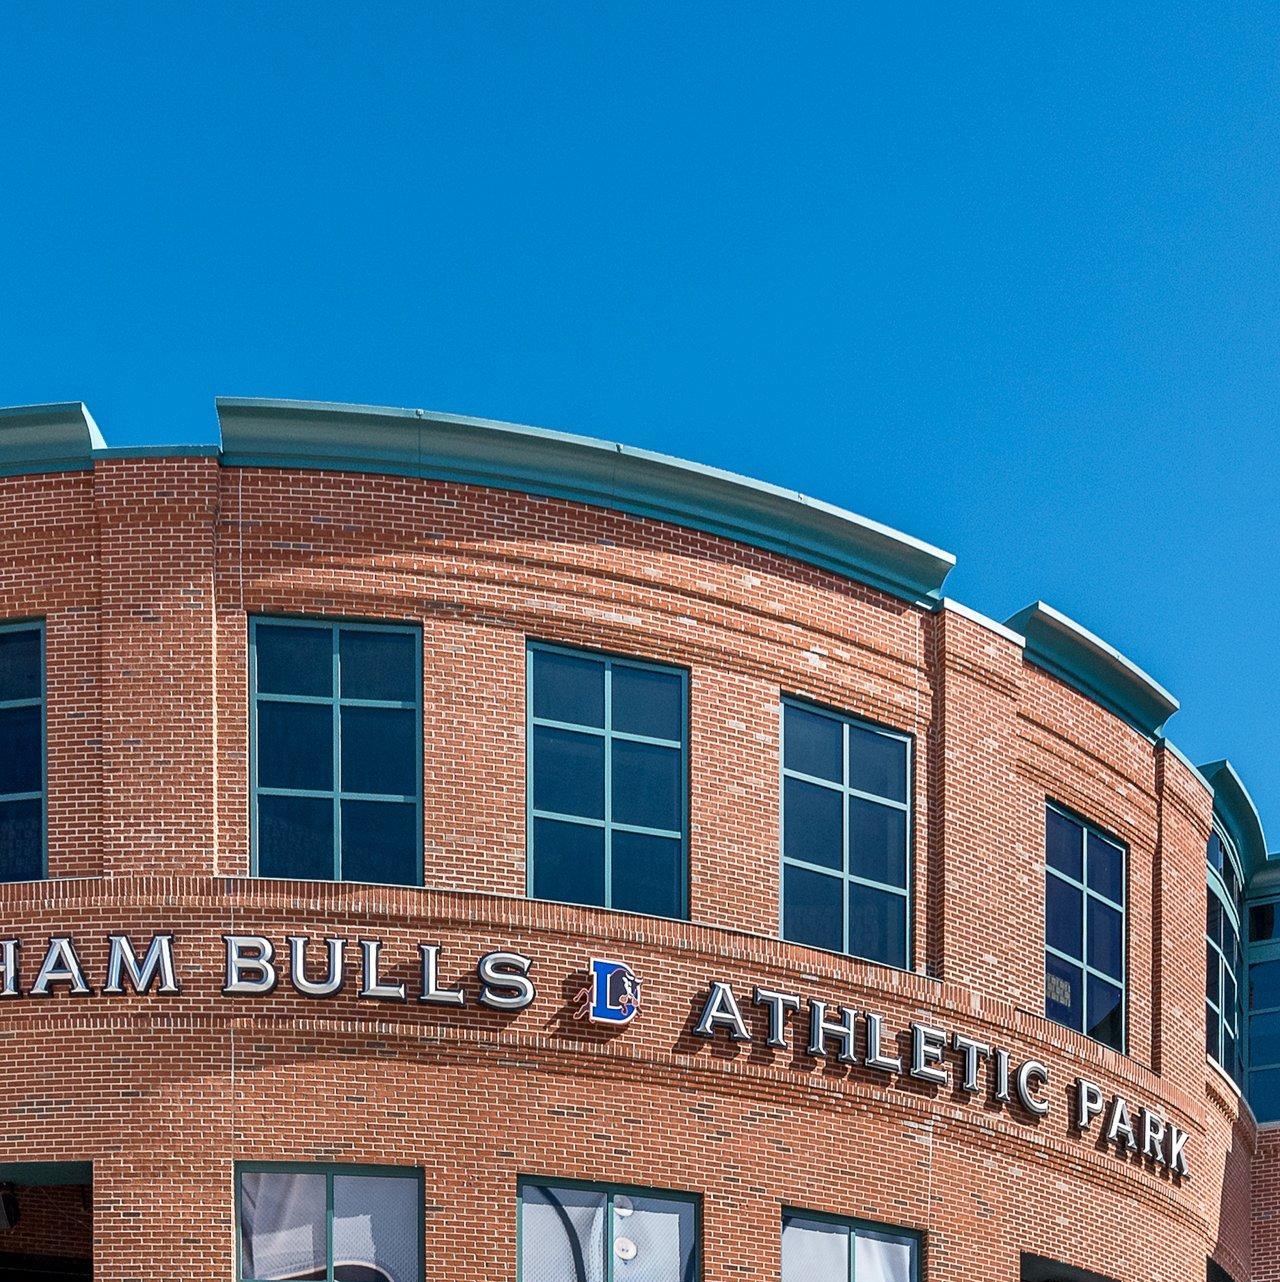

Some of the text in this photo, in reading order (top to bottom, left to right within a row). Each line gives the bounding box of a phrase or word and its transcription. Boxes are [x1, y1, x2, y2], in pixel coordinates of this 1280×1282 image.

[222, 934, 537, 1011] BULLS
[693, 980, 1192, 1178] ATHLETIC PARK
